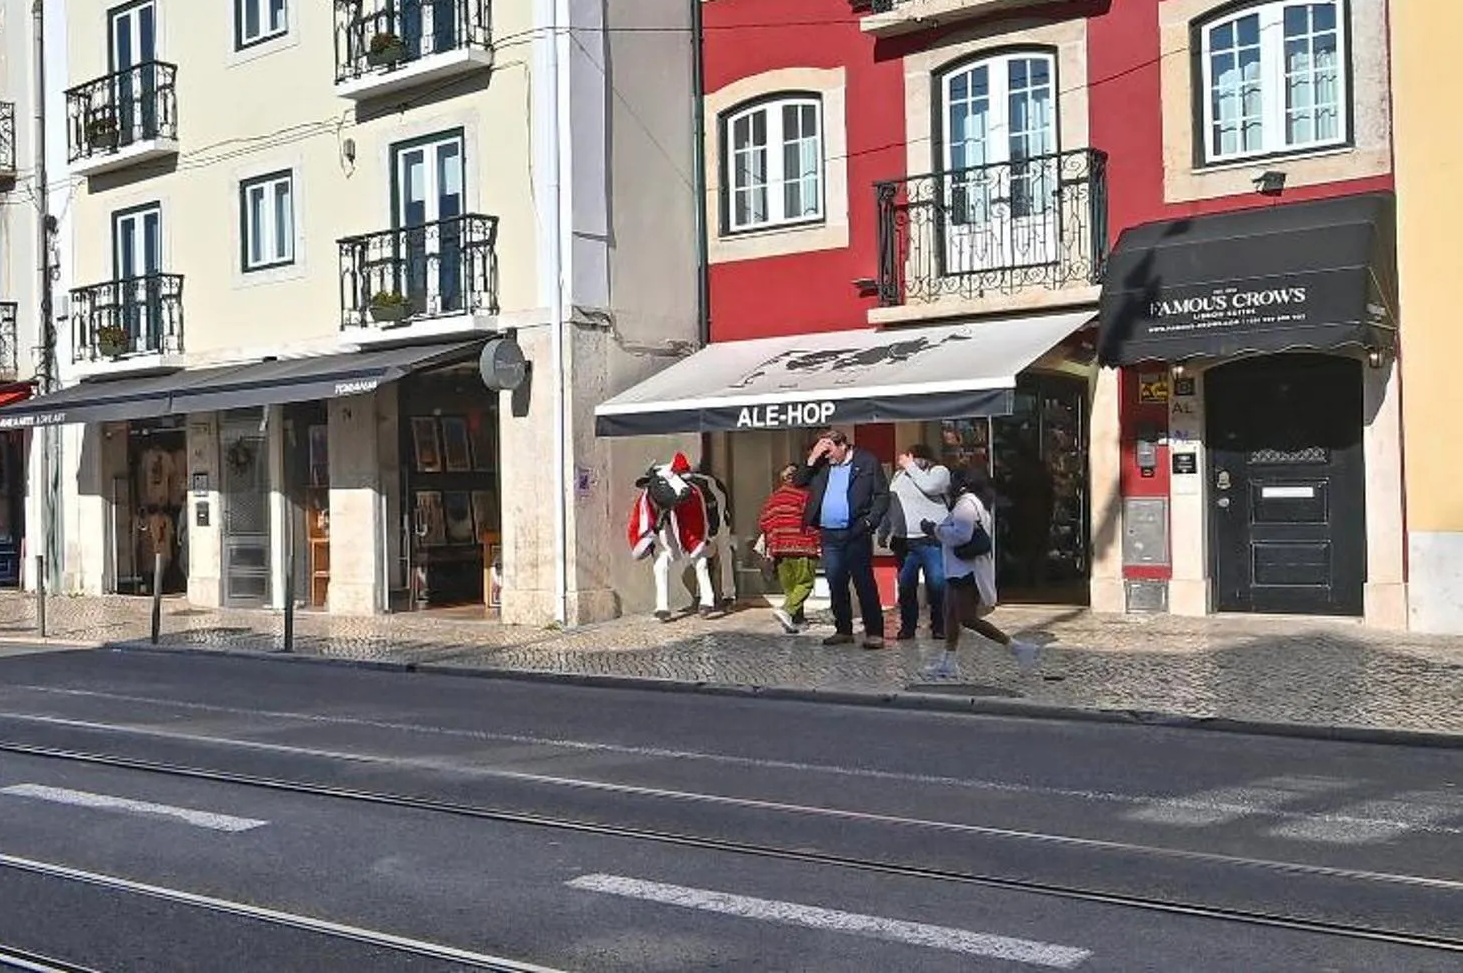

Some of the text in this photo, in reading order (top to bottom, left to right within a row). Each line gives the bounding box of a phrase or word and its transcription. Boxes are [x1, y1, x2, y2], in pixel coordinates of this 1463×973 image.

[1150, 287, 1306, 316] FAMOUS CROWS
[737, 401, 836, 427] ALE-HOP
